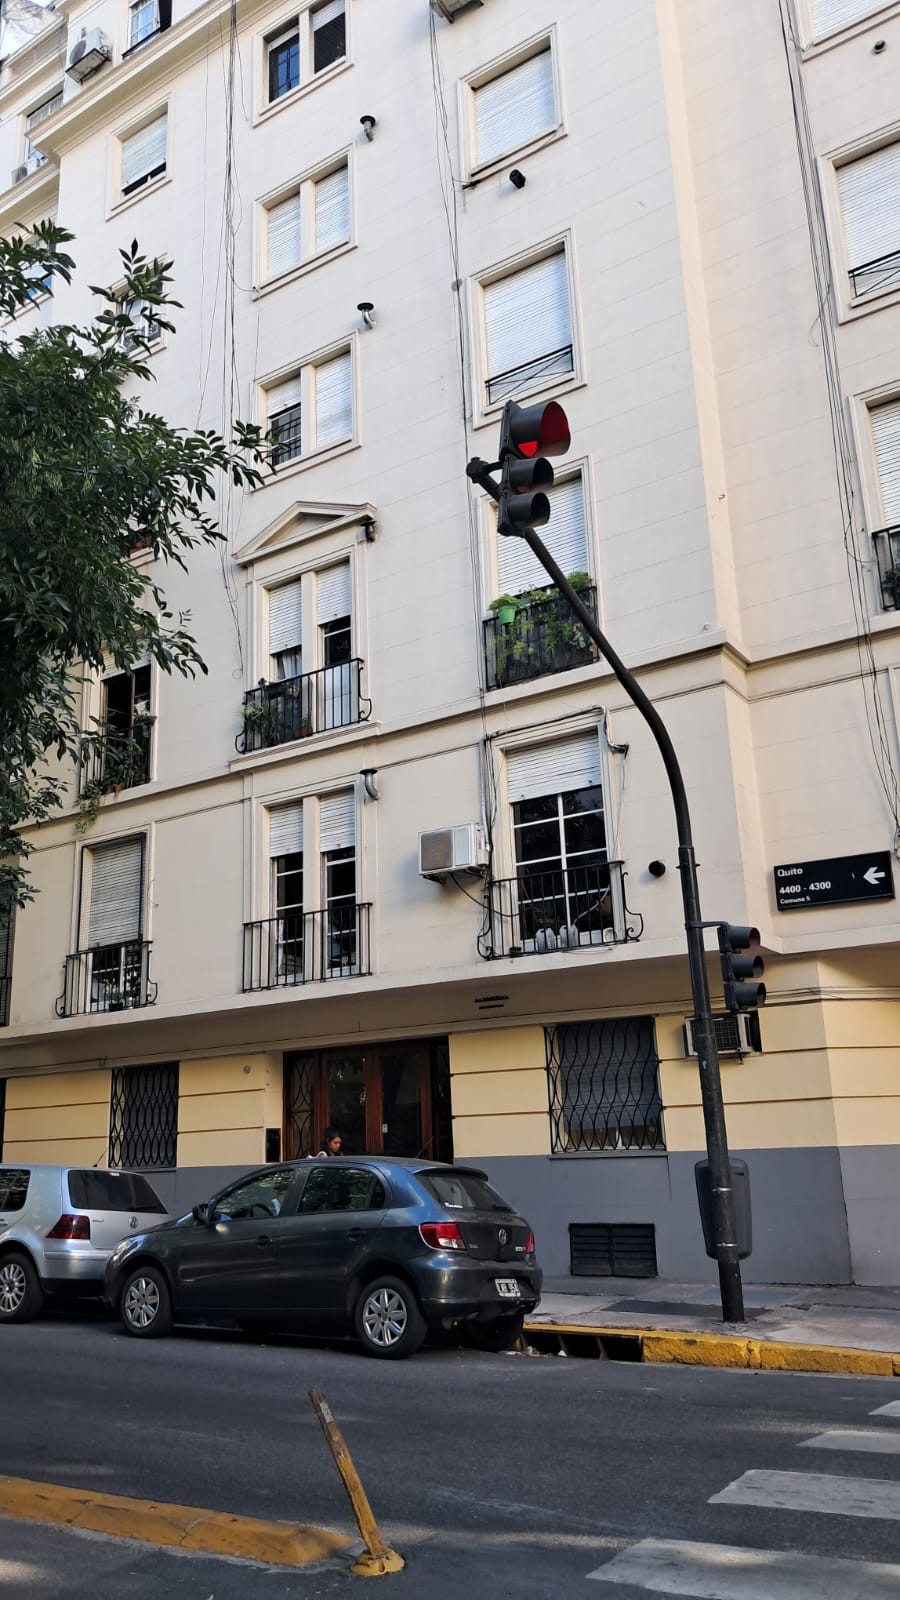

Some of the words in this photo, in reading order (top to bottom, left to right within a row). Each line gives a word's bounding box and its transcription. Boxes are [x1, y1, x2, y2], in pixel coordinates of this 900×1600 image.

[777, 868, 803, 877] Quito
[779, 885, 801, 894] 4400
[809, 881, 832, 891] 4300
